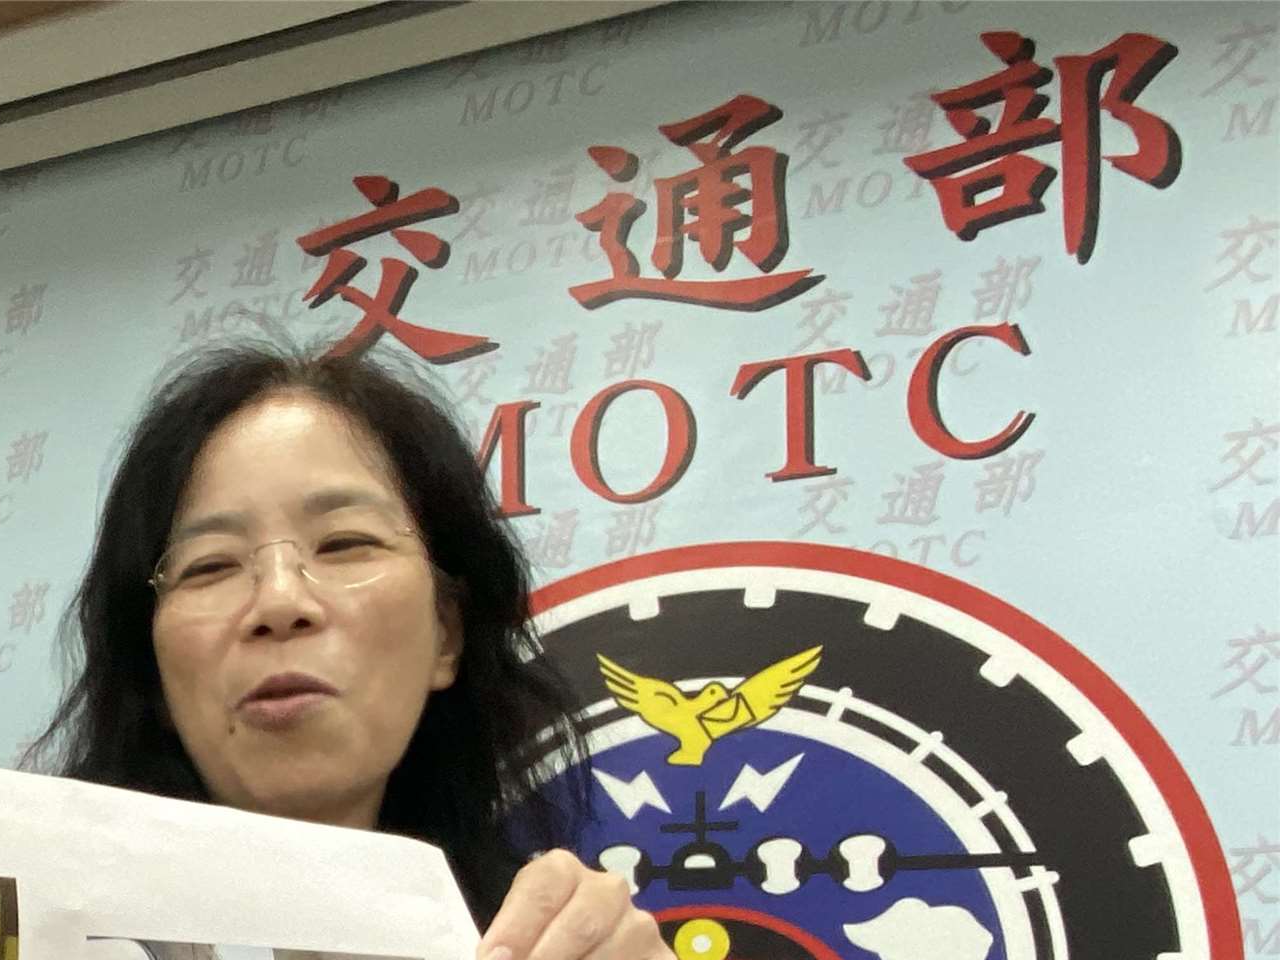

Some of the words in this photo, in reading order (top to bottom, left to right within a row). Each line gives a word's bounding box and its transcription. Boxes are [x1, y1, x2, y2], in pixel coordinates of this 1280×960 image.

[459, 62, 609, 127] MOTC
[180, 136, 307, 192] MOTC
[297, 31, 1182, 365] 交通部
[791, 255, 1042, 352] 交通部
[794, 449, 1046, 537] 交通部
